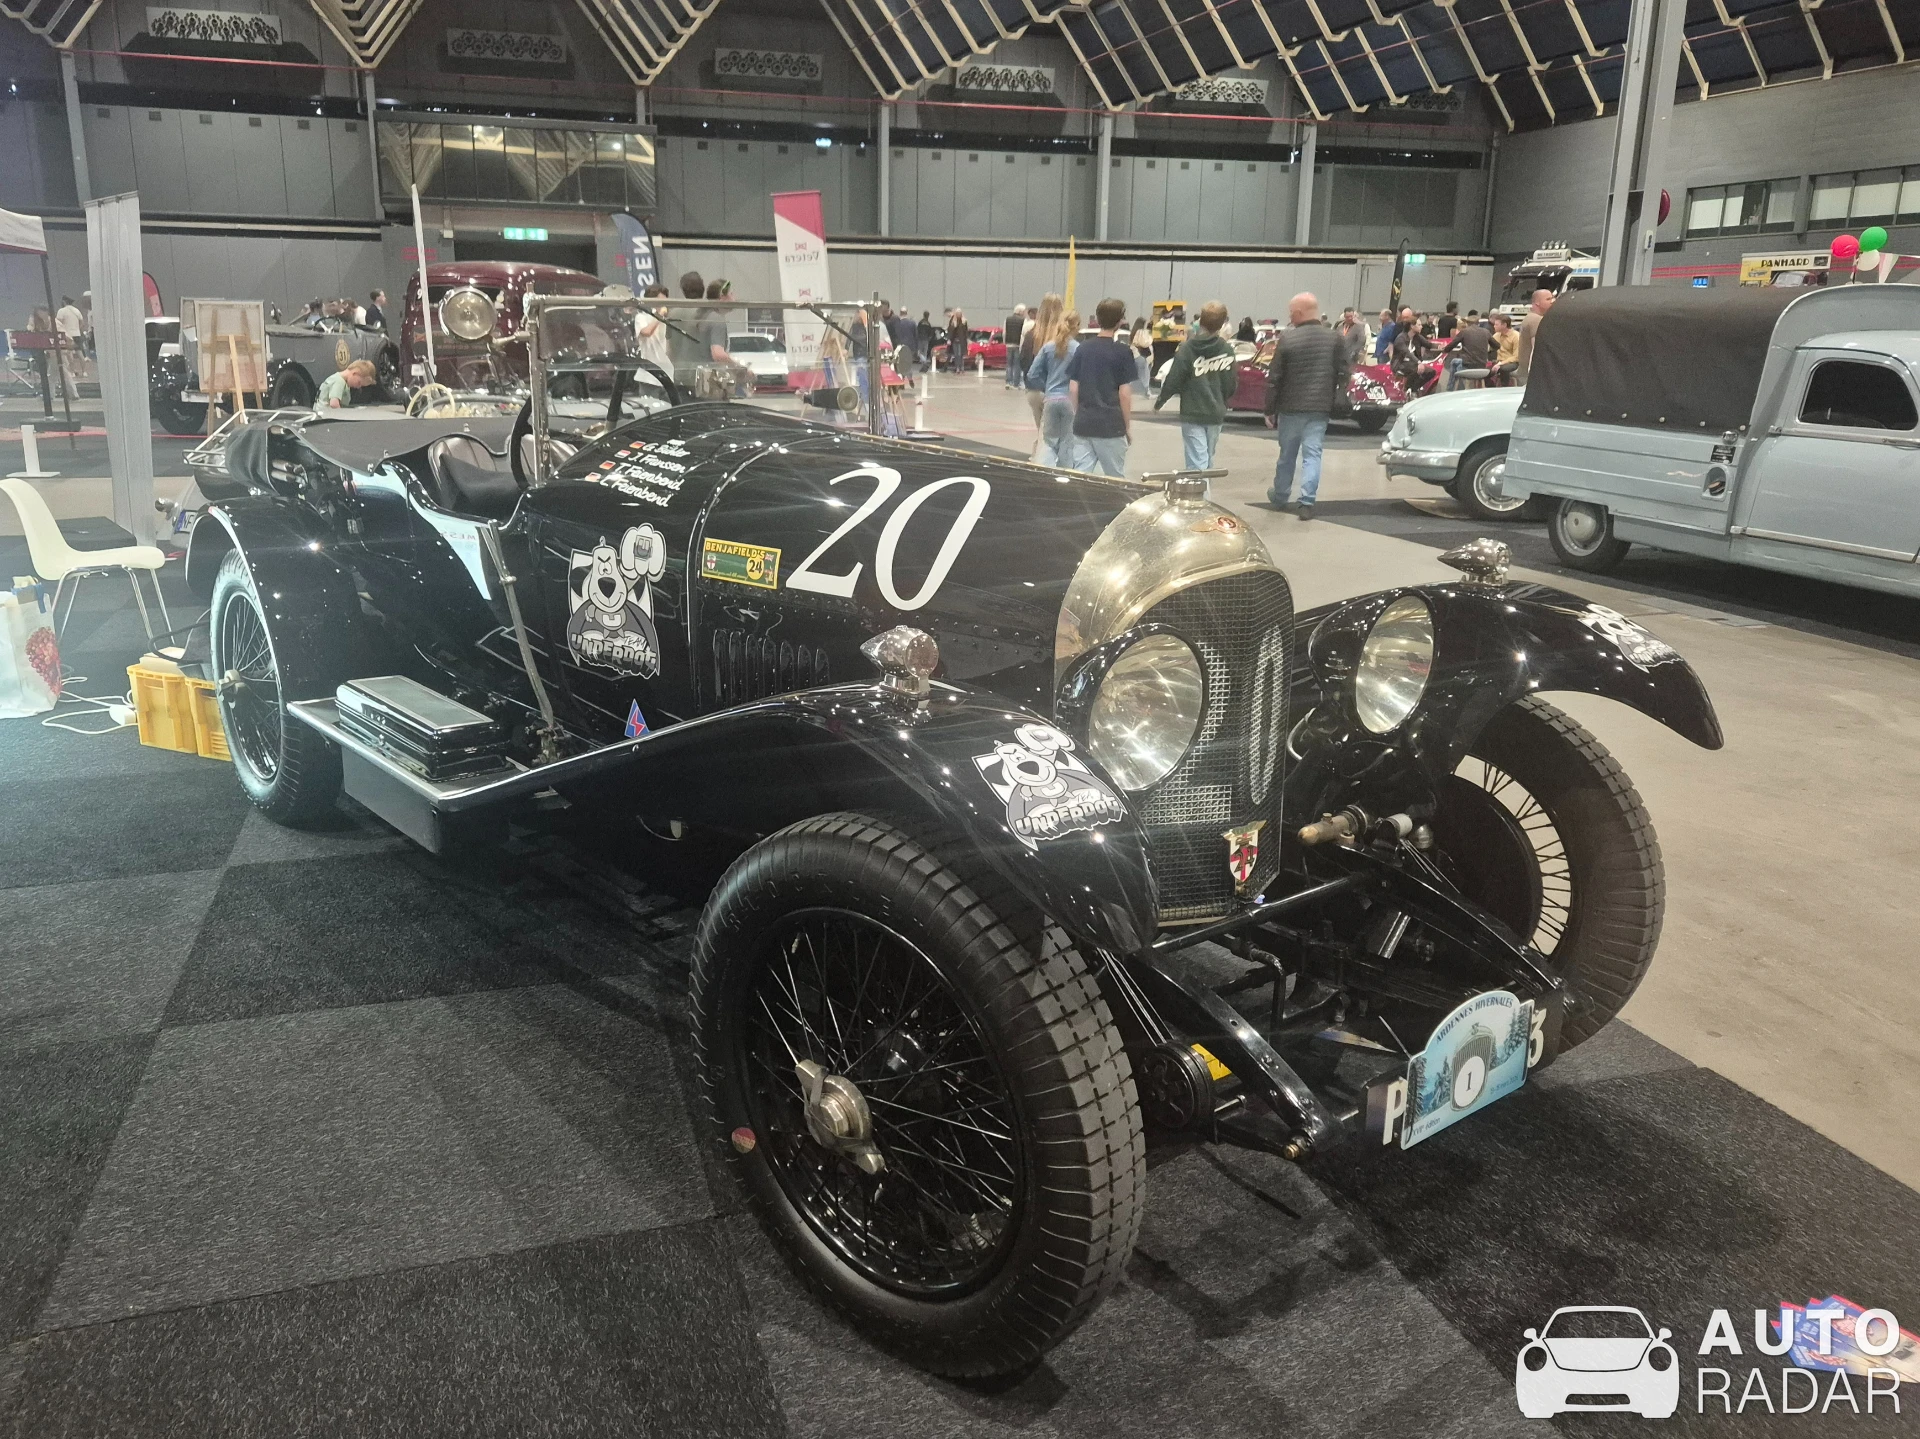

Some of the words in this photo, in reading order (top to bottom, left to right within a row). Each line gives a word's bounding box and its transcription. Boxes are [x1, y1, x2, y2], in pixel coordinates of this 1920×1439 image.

[1761, 257, 1810, 268] PANHARD
[705, 541, 766, 560] BENJAFIELD'S
[785, 467, 991, 611] 20
[748, 559, 763, 574] 24
[571, 633, 657, 667] UNDERDOG
[1015, 797, 1121, 836] UNDERDOG
[1436, 1006, 1474, 1044] ARDENNES
[1474, 996, 1514, 1012] HIVERNALES
